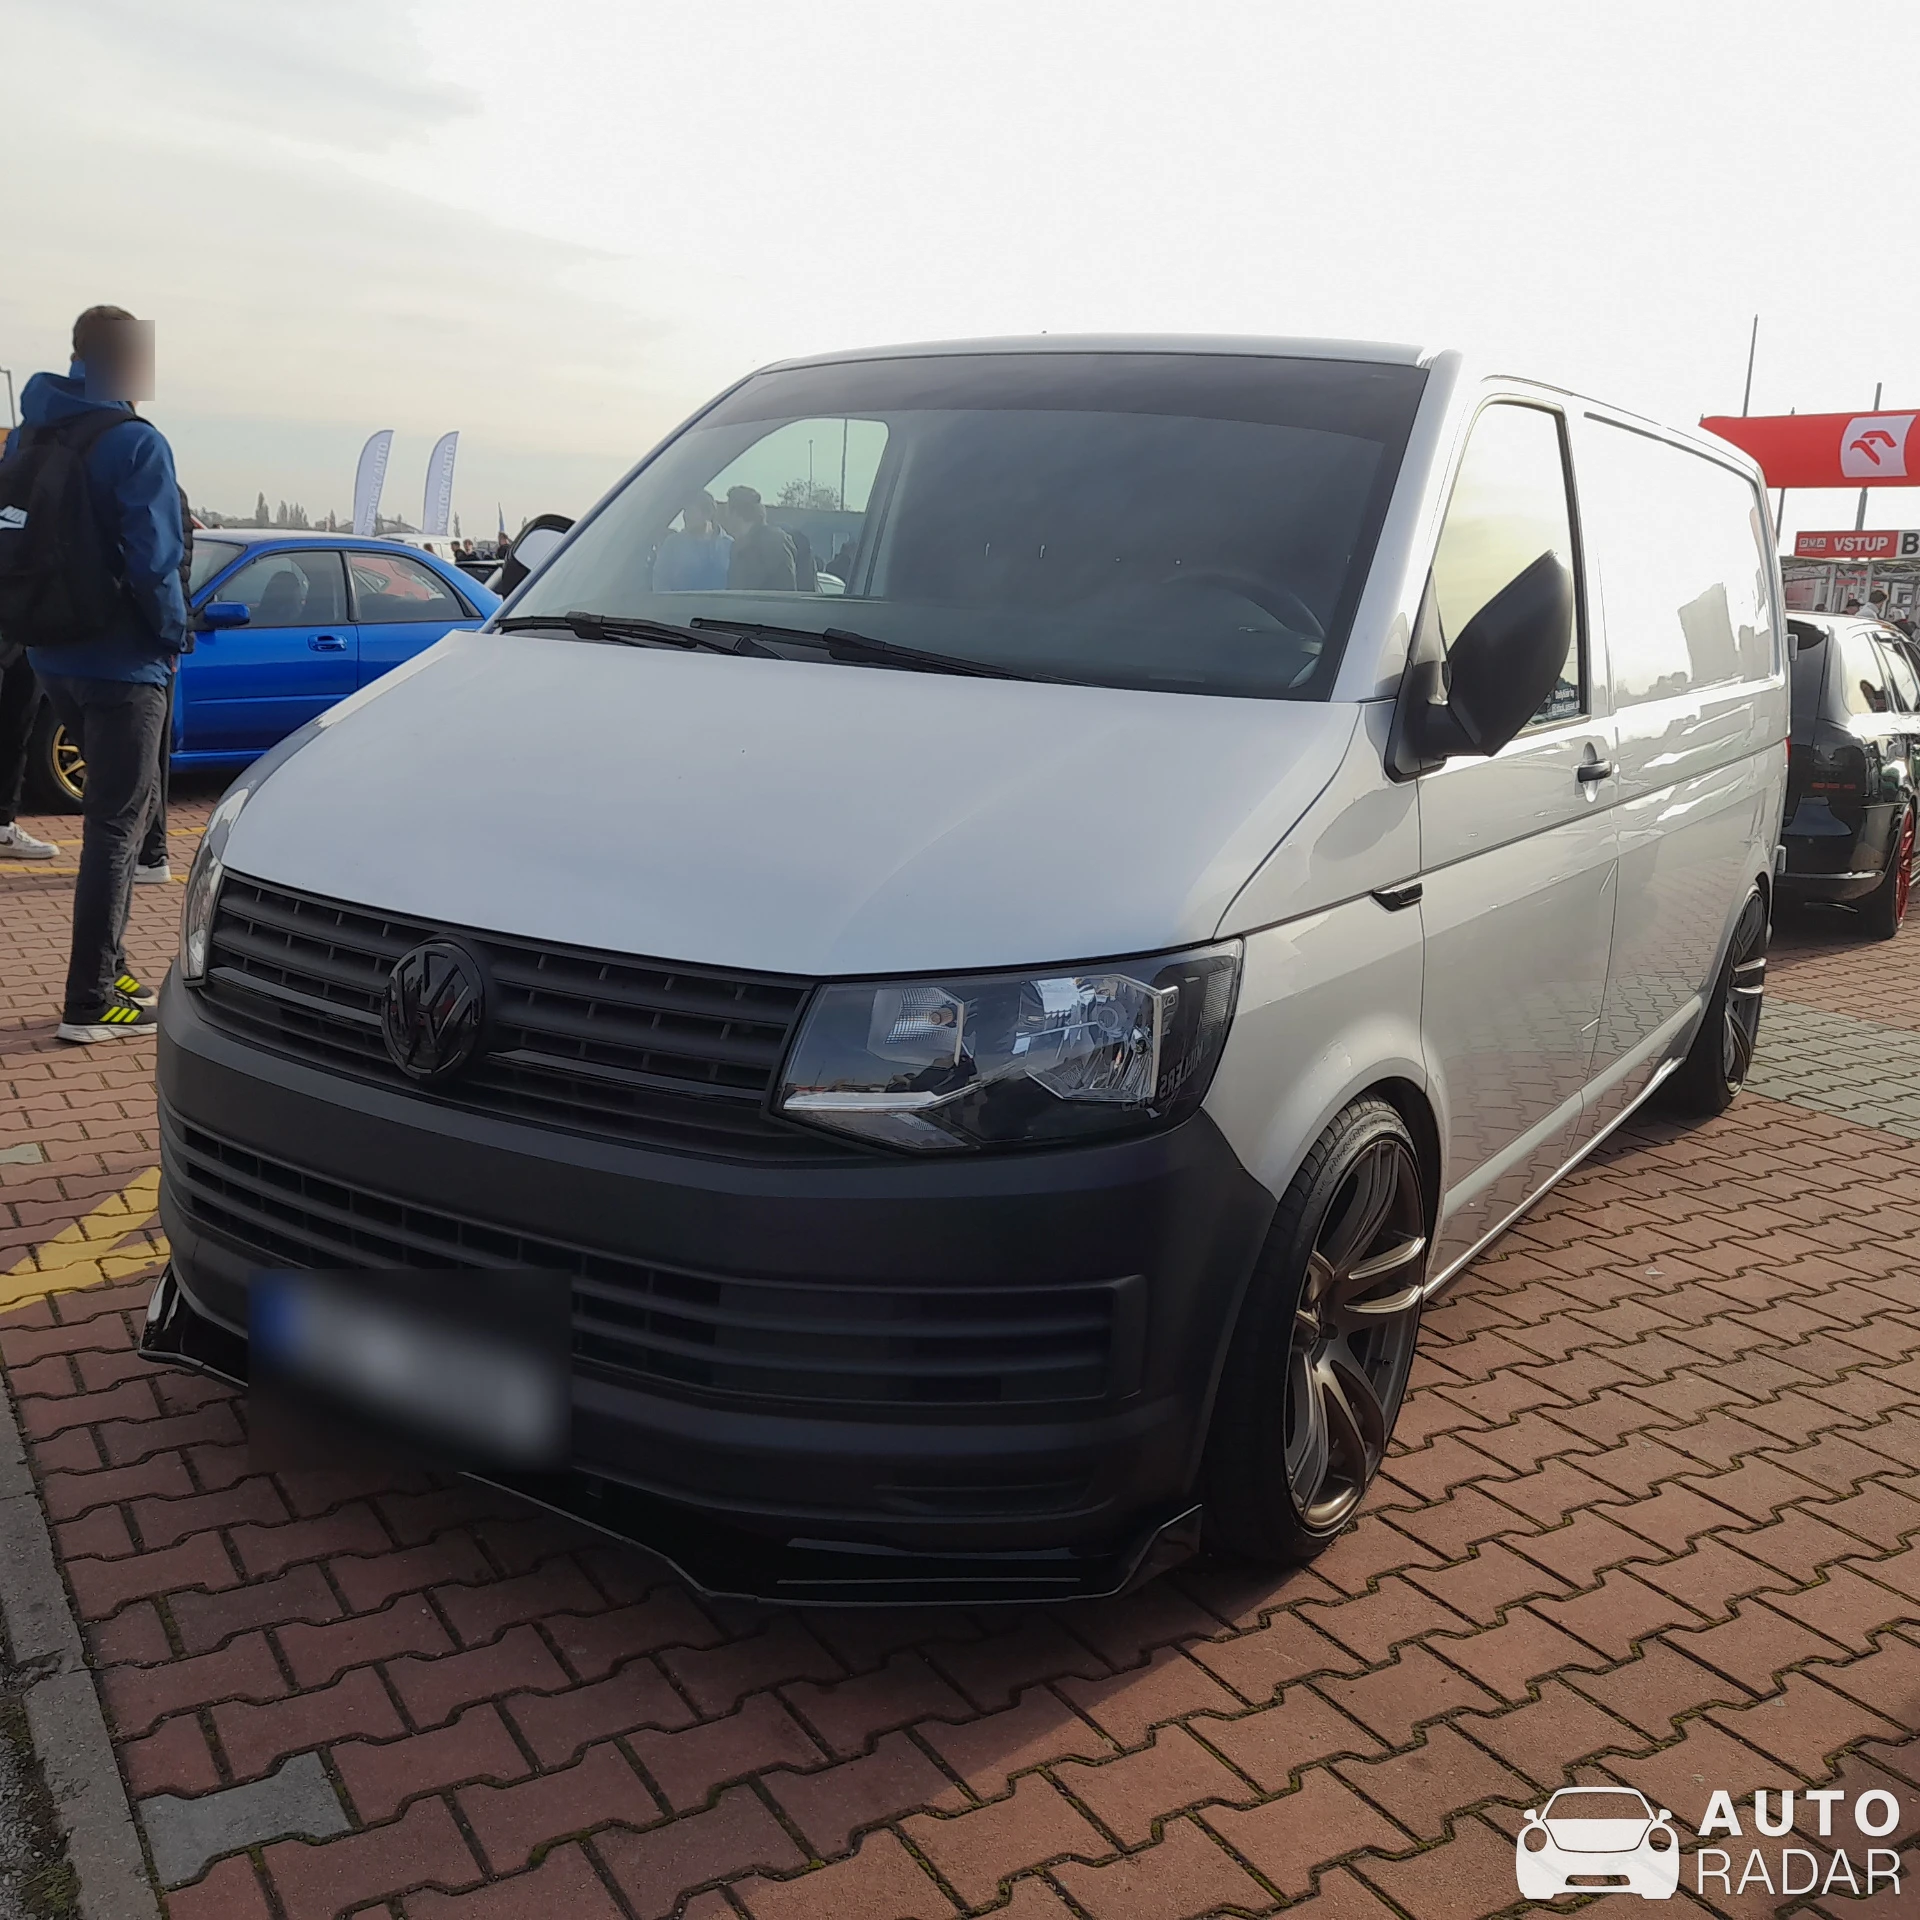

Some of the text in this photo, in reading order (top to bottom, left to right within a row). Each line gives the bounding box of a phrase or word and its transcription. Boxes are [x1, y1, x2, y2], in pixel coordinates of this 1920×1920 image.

[374, 442, 389, 475] AUTO
[437, 443, 456, 531] VICTORY AUTO
[1834, 532, 1920, 555] VSTUP B
